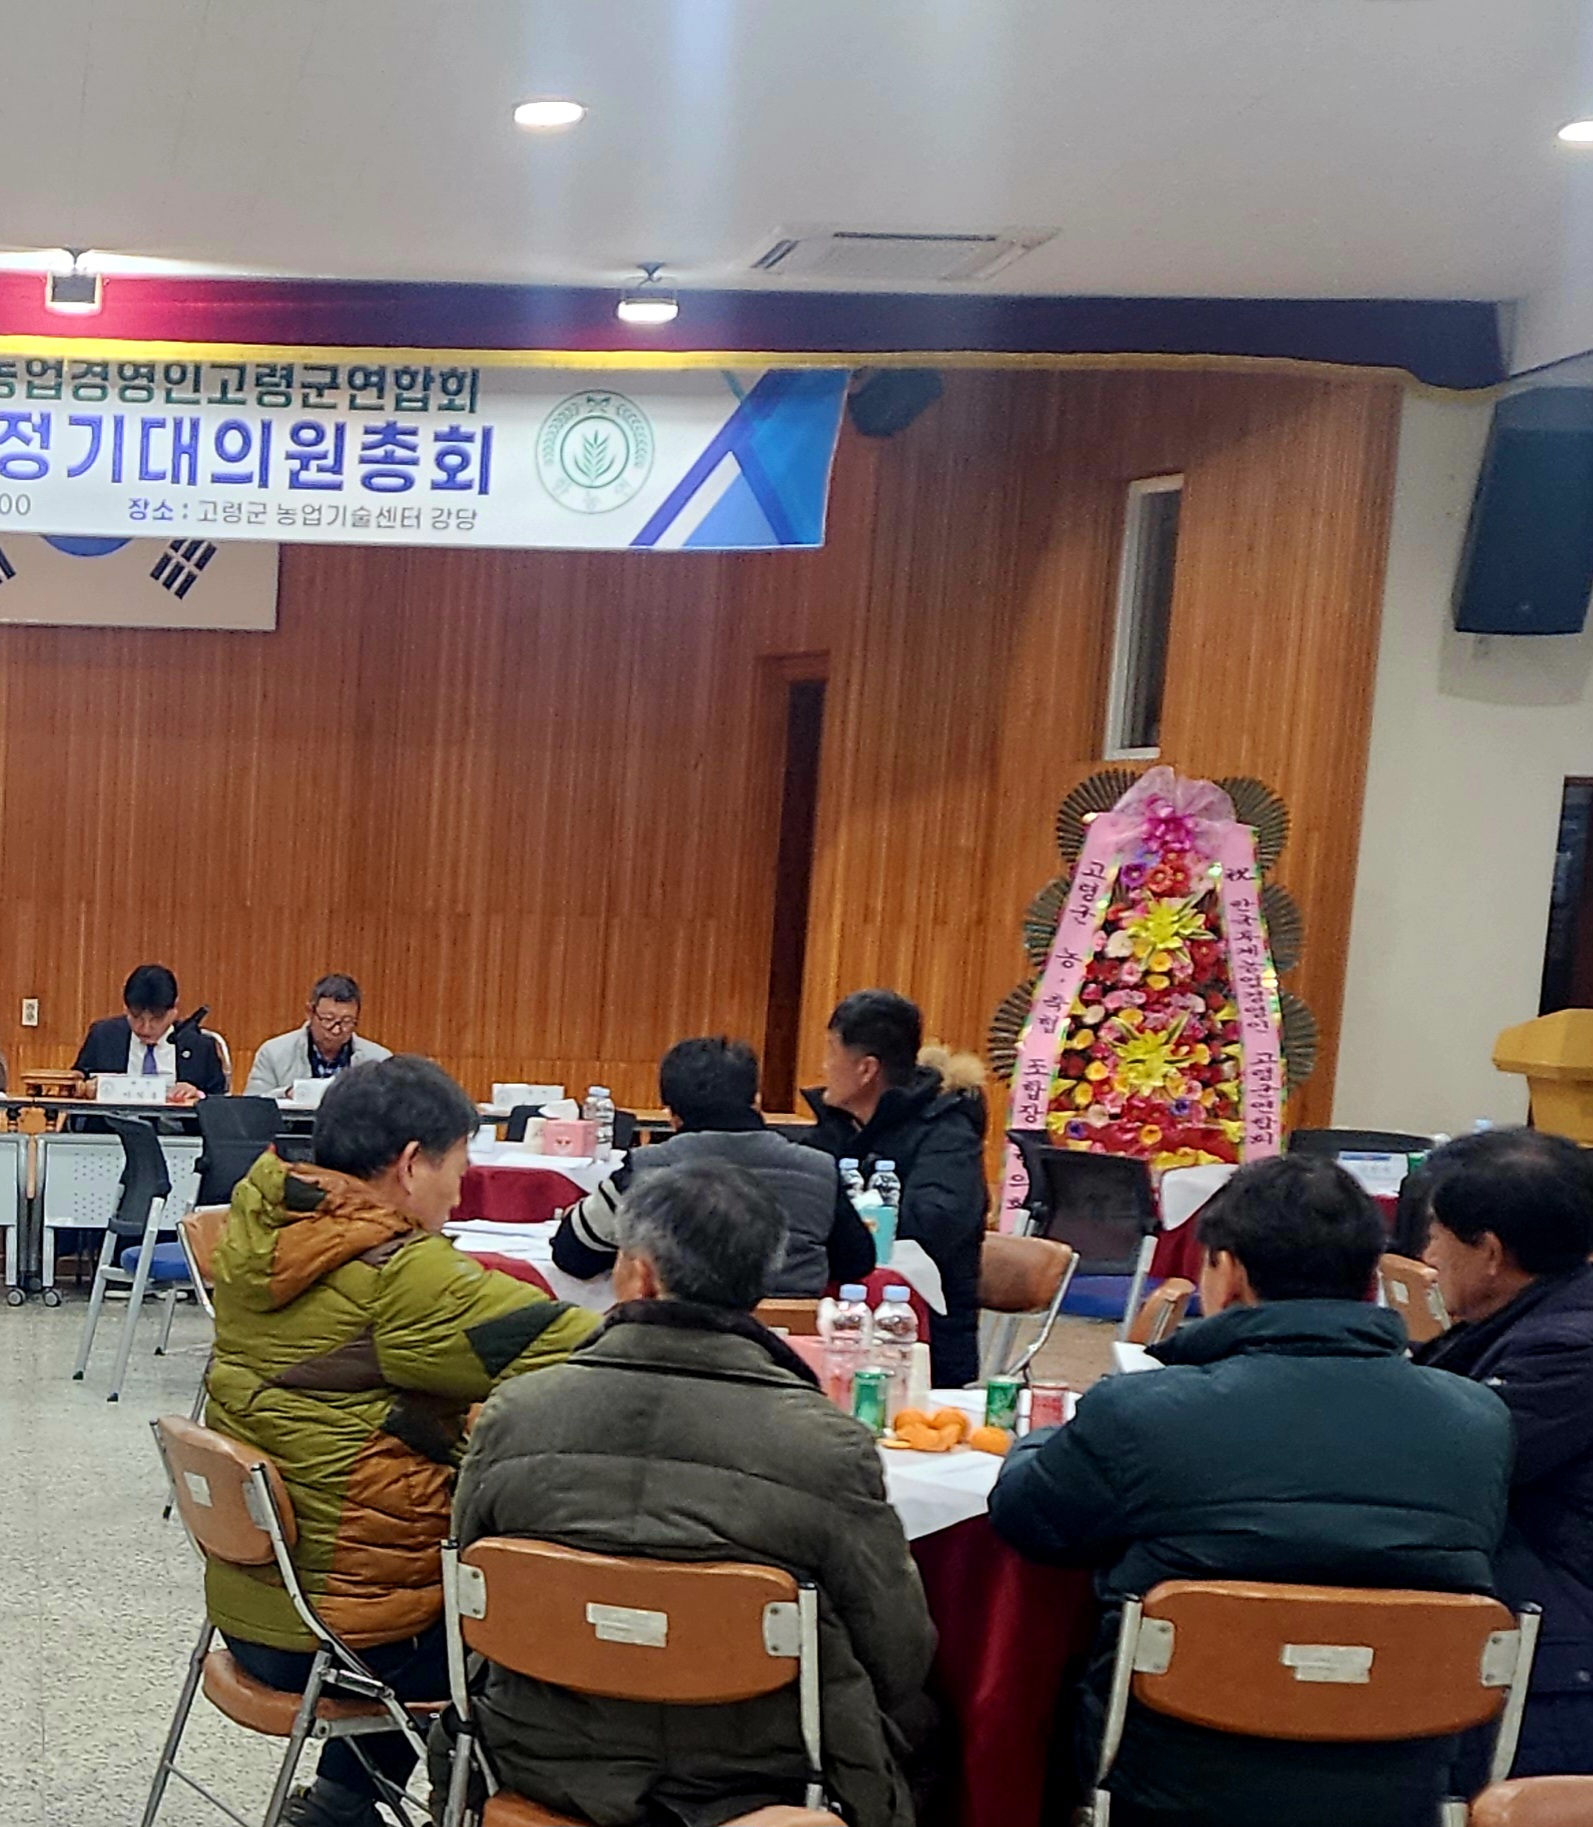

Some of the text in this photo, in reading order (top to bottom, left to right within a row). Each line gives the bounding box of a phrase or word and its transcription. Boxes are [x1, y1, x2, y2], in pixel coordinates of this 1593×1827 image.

[196, 500, 269, 527] 고령군
[276, 502, 423, 532] 농업기술센터
[430, 505, 479, 532] 강당
[1069, 861, 1108, 926] 고령군
[1017, 1058, 1052, 1124] 조합장
